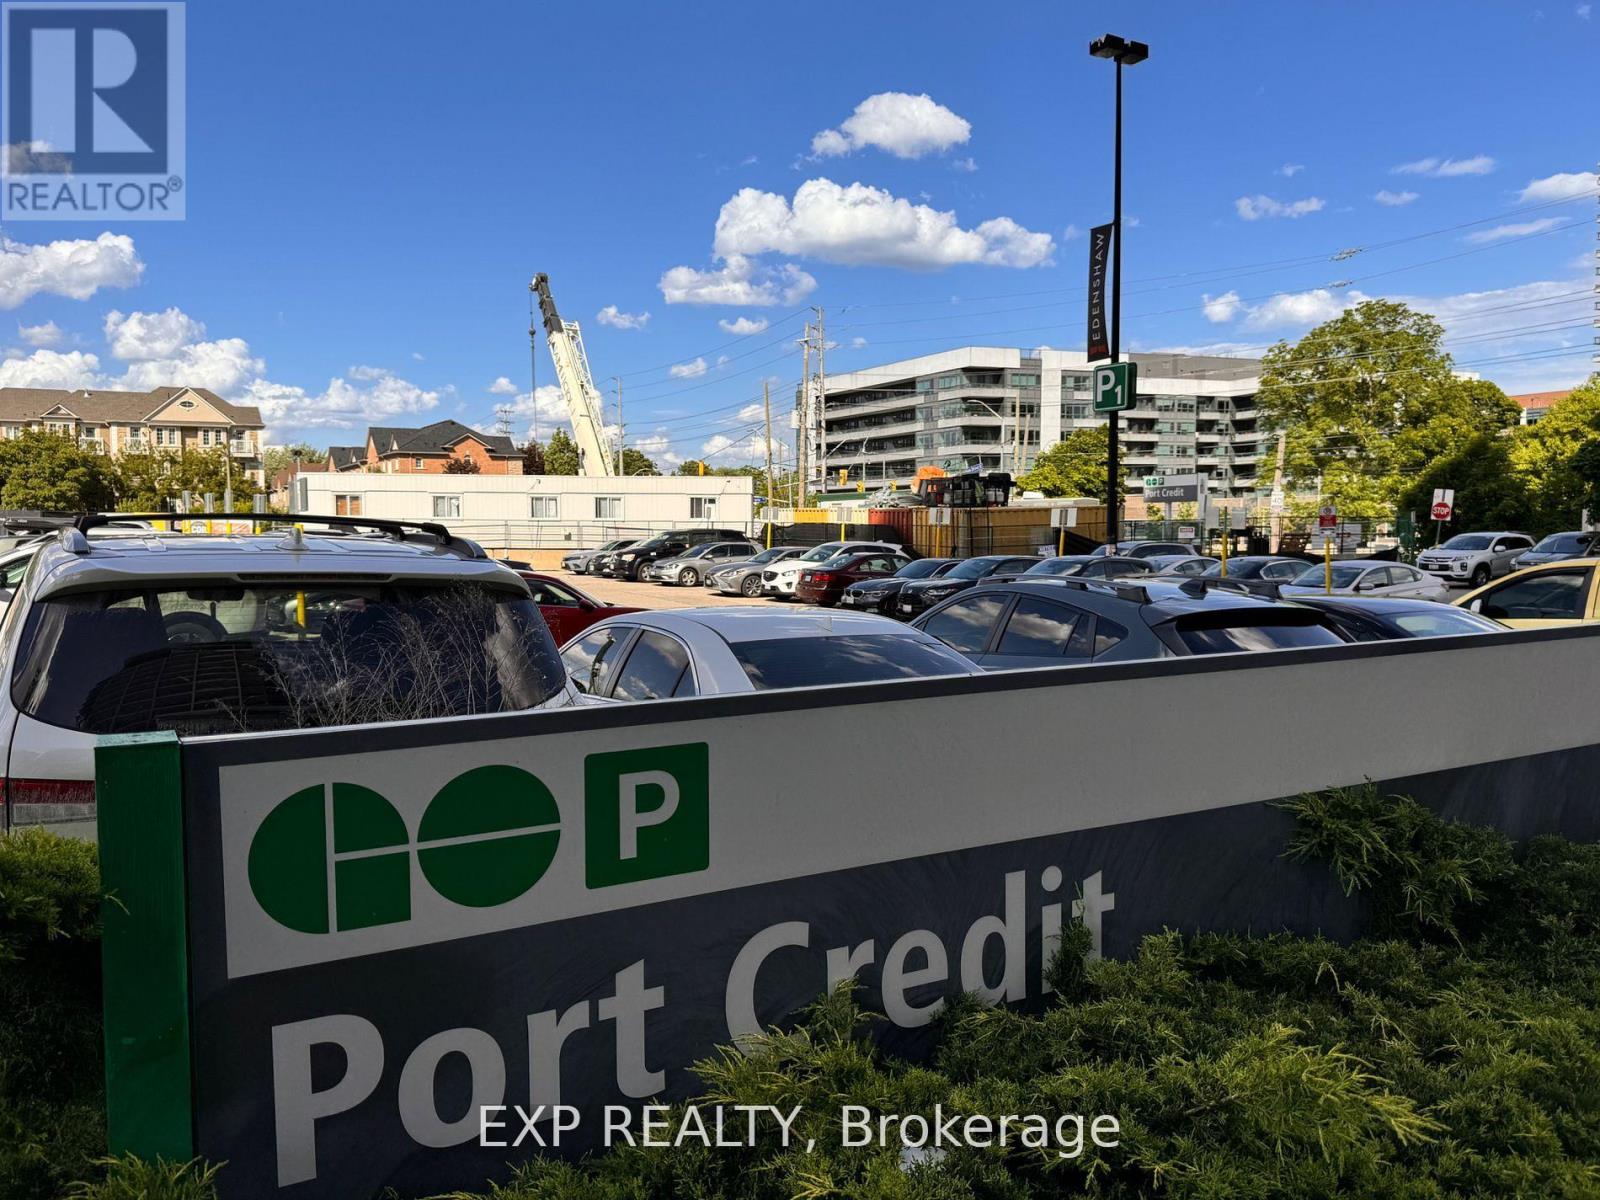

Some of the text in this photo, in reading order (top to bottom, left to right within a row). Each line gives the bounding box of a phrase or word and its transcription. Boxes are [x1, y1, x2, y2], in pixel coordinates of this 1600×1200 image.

[1092, 233, 1105, 341] EDENSHAW
[1145, 488, 1184, 498] Port Credit
[1433, 507, 1449, 515] STOP
[619, 769, 681, 861] P
[271, 865, 1115, 1188] Port Credit
